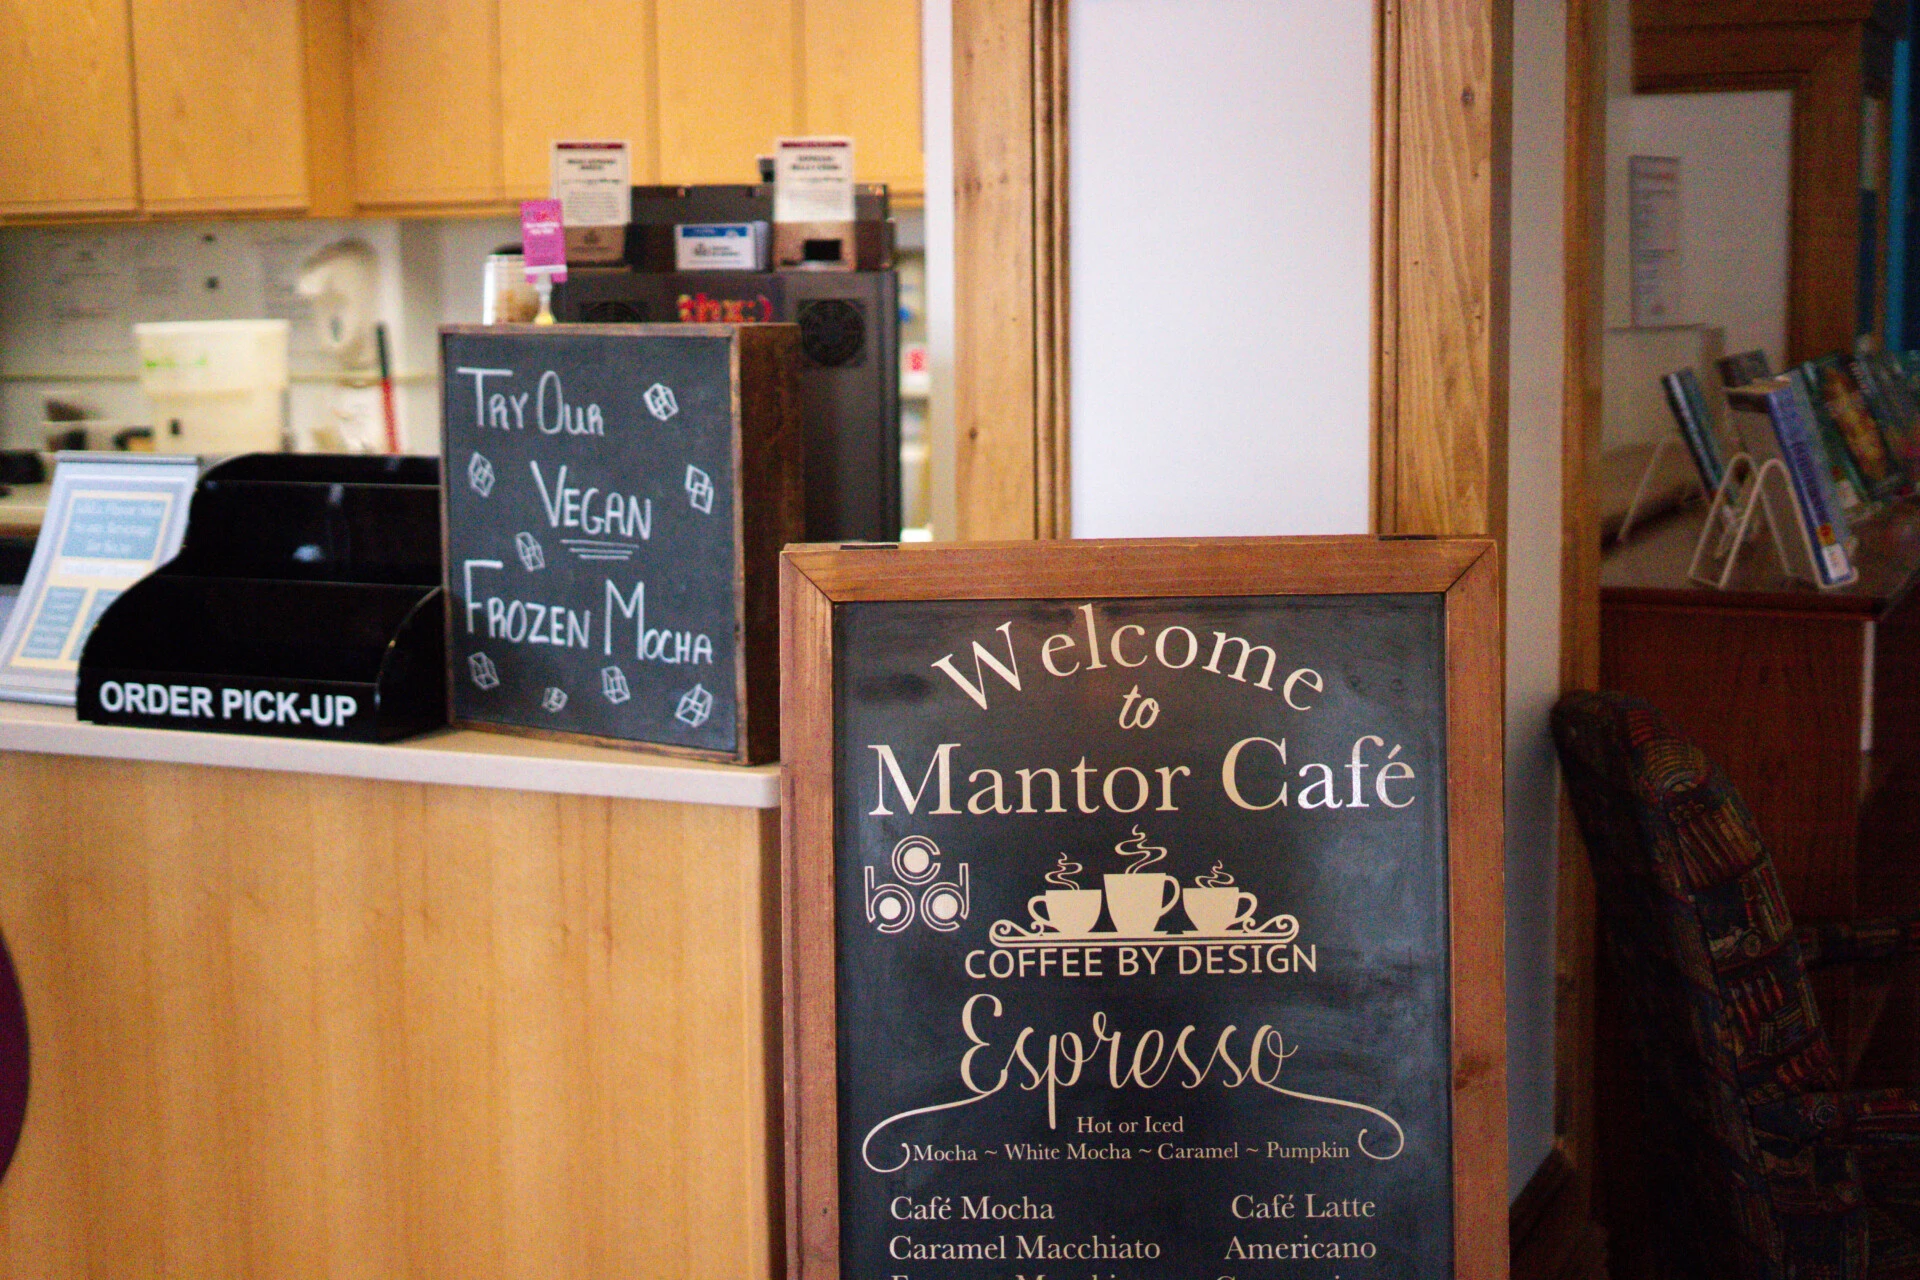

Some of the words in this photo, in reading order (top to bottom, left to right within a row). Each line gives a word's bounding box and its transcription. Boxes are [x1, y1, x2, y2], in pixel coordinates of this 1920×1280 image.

[931, 603, 1324, 711] Welcome
[100, 680, 215, 718] ORDER
[222, 688, 357, 727] PICK-UP
[1118, 684, 1160, 729] to
[867, 742, 1191, 816] Mantor
[1221, 734, 1416, 811] Café
[964, 946, 1103, 979] COFFEE
[1117, 946, 1164, 975] BY
[1177, 943, 1317, 974] DESIGN
[958, 993, 1299, 1130] Espresso
[1076, 1115, 1113, 1134] Hot
[1118, 1121, 1139, 1134] or
[1144, 1115, 1184, 1133] Iced
[912, 1143, 978, 1162] Mocha
[1004, 1142, 1060, 1161] White
[1066, 1142, 1132, 1160] Mocha
[1157, 1141, 1239, 1160] Caramel
[1266, 1140, 1350, 1164] Pumpkin
[890, 1195, 952, 1221] Café
[960, 1195, 1055, 1220] Mocha
[1231, 1193, 1295, 1219] Café
[1304, 1193, 1376, 1218] Latte
[888, 1235, 1007, 1260] Caramel
[1015, 1234, 1161, 1260] Macchiato
[1224, 1234, 1377, 1260] Americano
